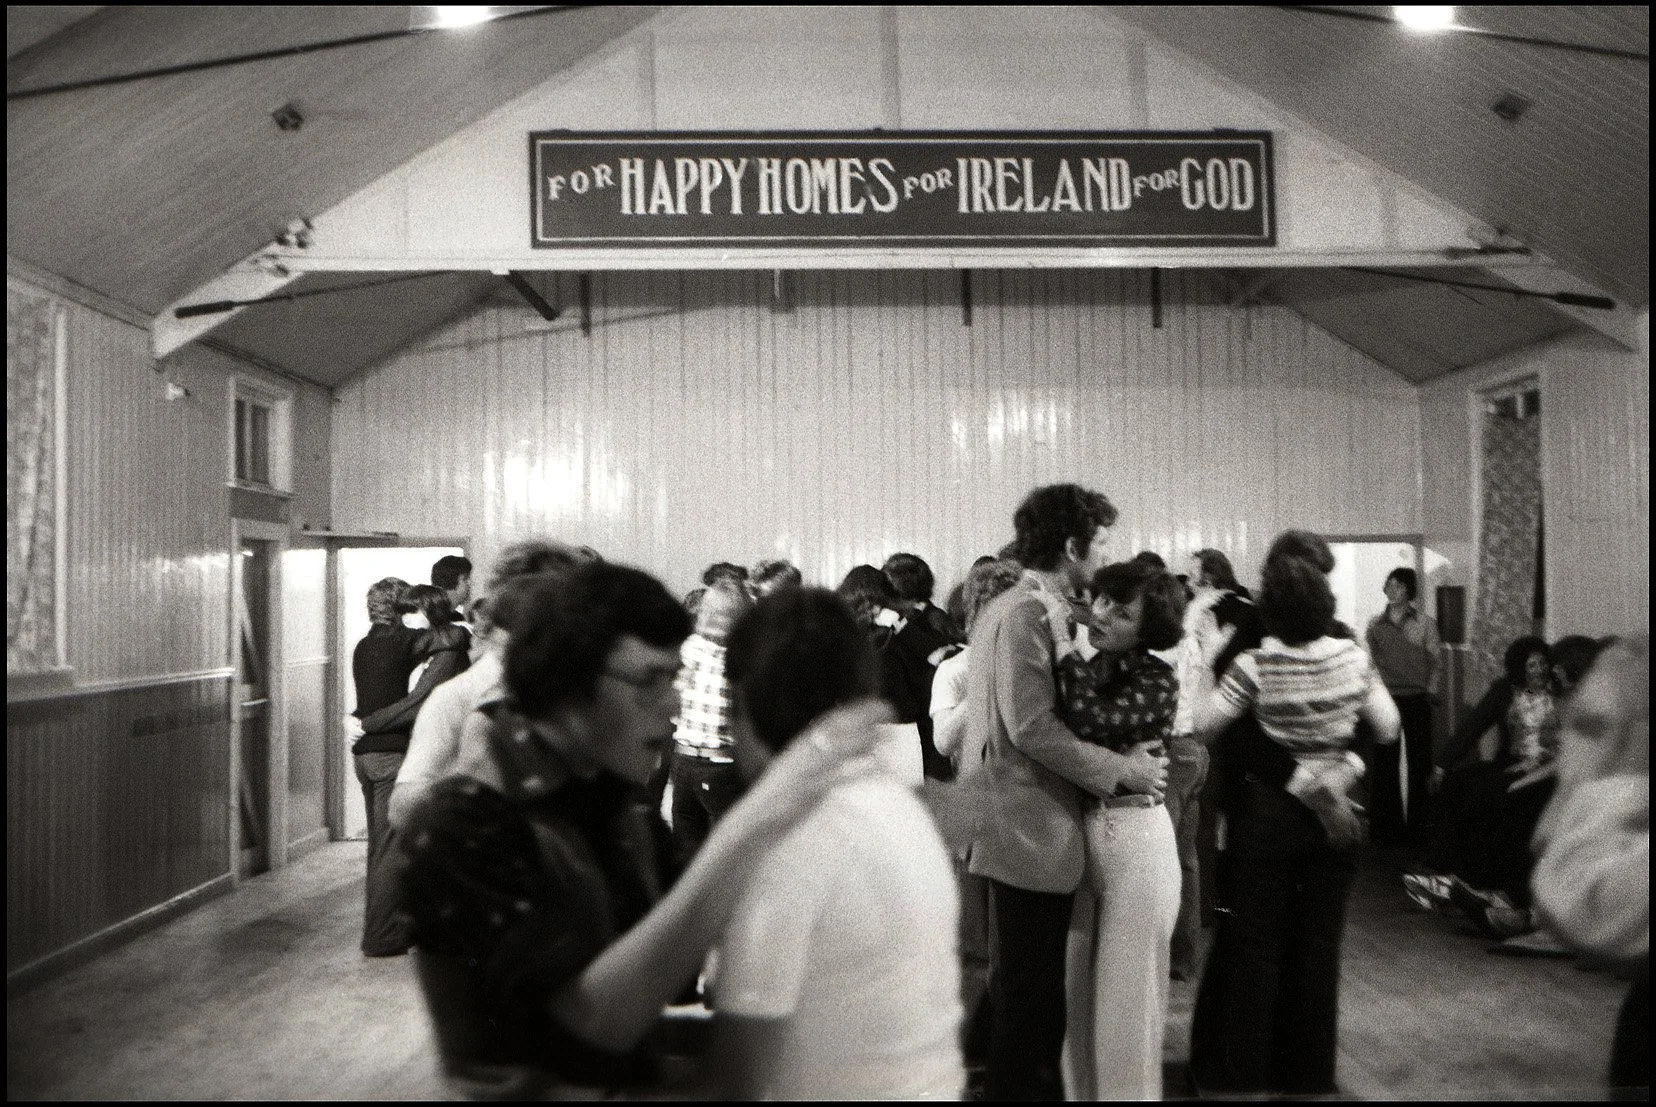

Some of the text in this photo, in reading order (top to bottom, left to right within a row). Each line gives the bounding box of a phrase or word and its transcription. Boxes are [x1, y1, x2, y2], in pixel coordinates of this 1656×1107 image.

[547, 157, 1254, 216] FOR HAPPY HOMES FOR IRELAND FOR GOD
